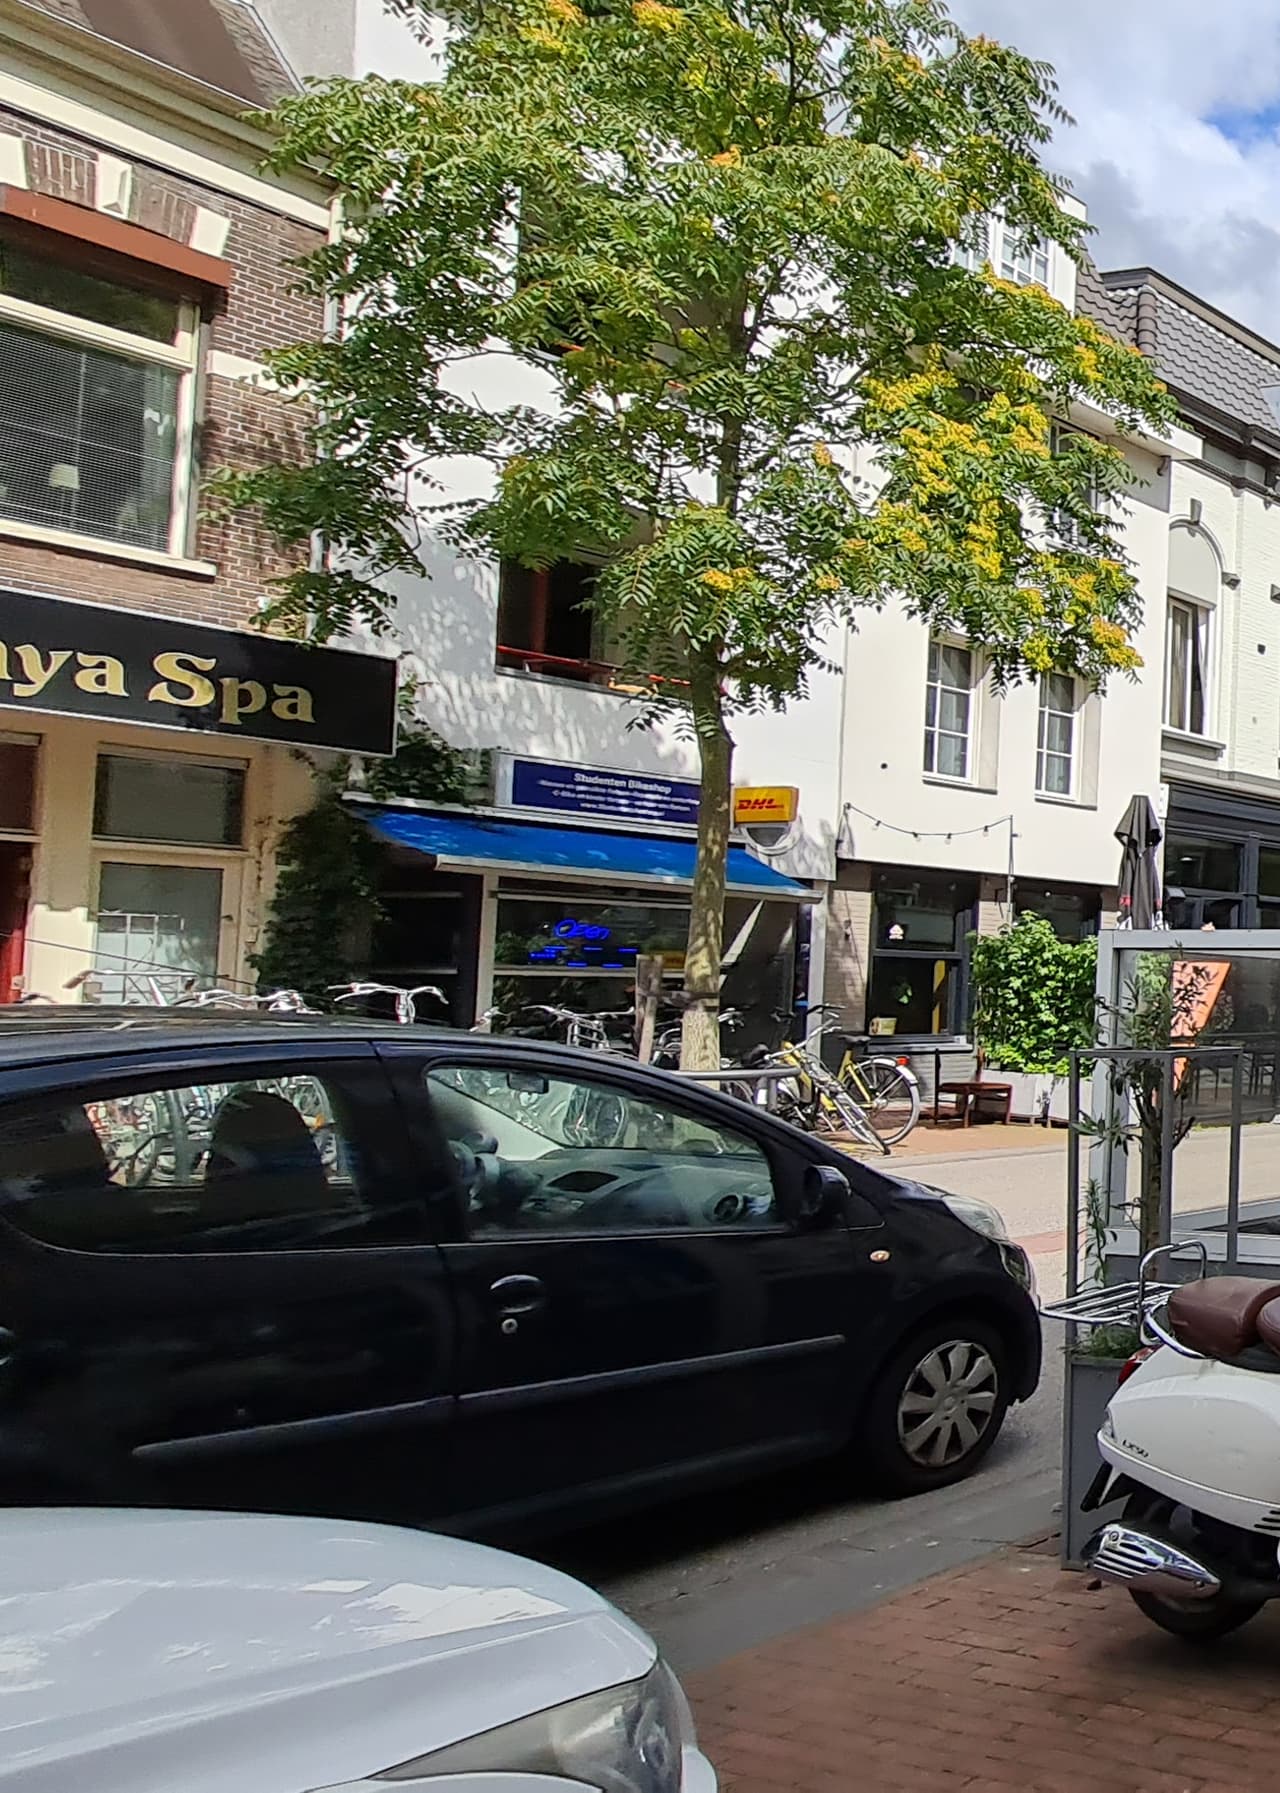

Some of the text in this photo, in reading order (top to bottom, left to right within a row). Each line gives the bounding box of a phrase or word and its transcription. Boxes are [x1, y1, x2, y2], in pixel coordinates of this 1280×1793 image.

[147, 651, 316, 726] Spa
[573, 773, 627, 787] Studenten
[737, 799, 779, 811] DHL
